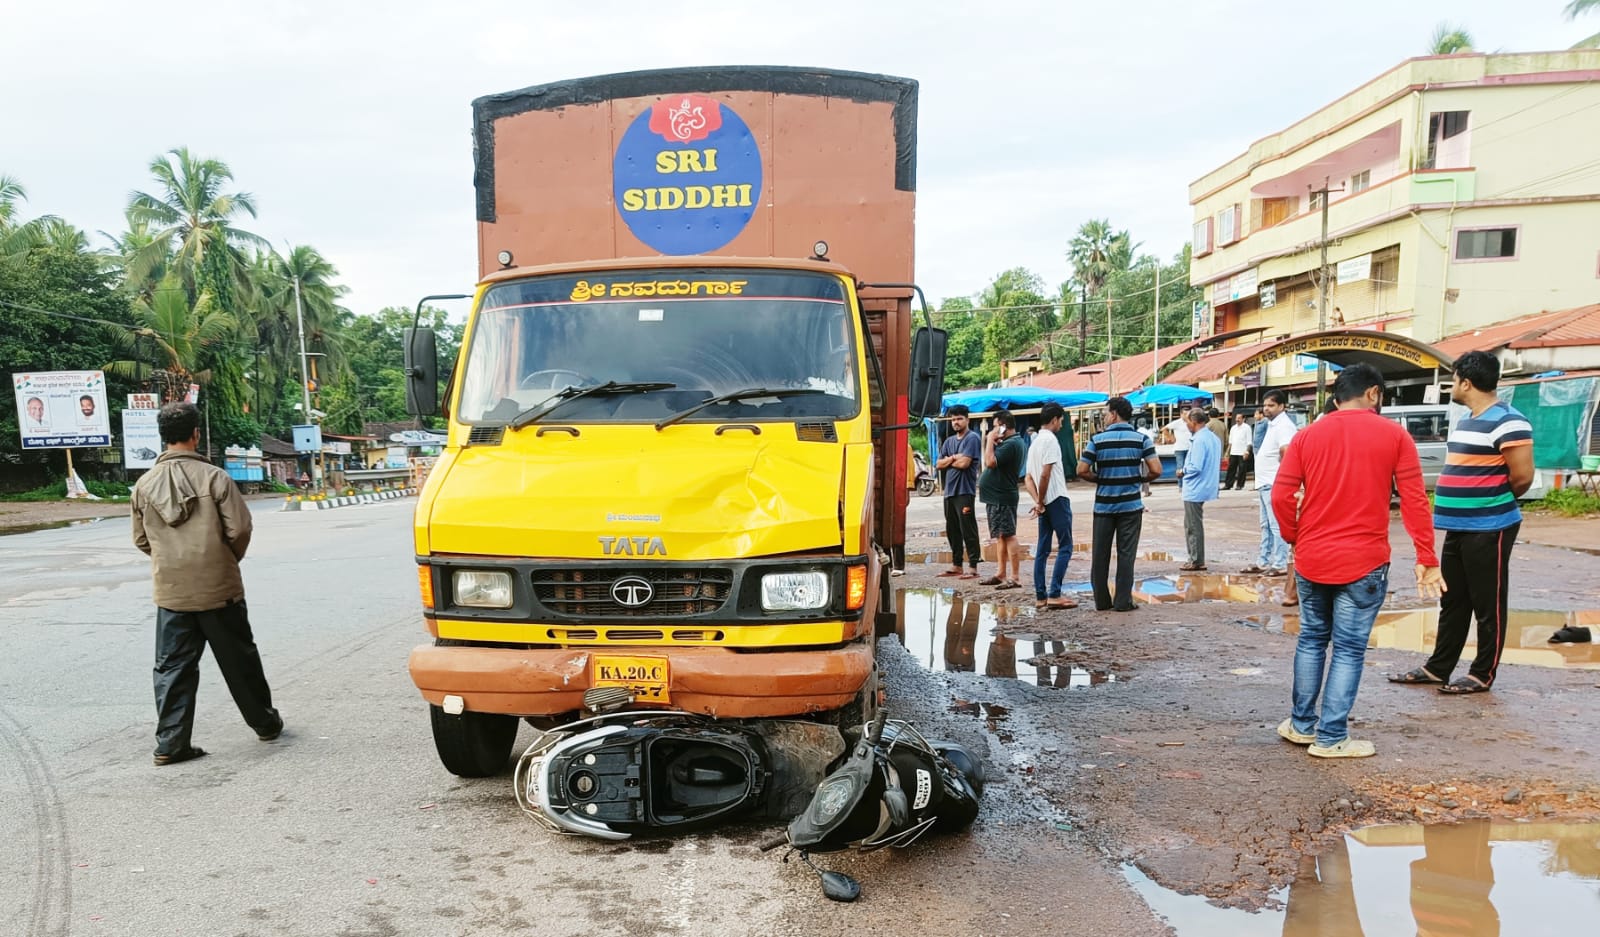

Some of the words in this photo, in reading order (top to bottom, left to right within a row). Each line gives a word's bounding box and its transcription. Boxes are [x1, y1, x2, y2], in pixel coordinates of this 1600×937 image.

[655, 149, 718, 174] SRI
[622, 184, 753, 212] SIDDHI
[570, 279, 606, 301] ಶ್ರೀ
[610, 280, 748, 297] ನವದುರ್ಗಾ
[133, 394, 152, 402] BAR
[598, 536, 668, 556] TATA
[600, 666, 662, 680] KA.20.C
